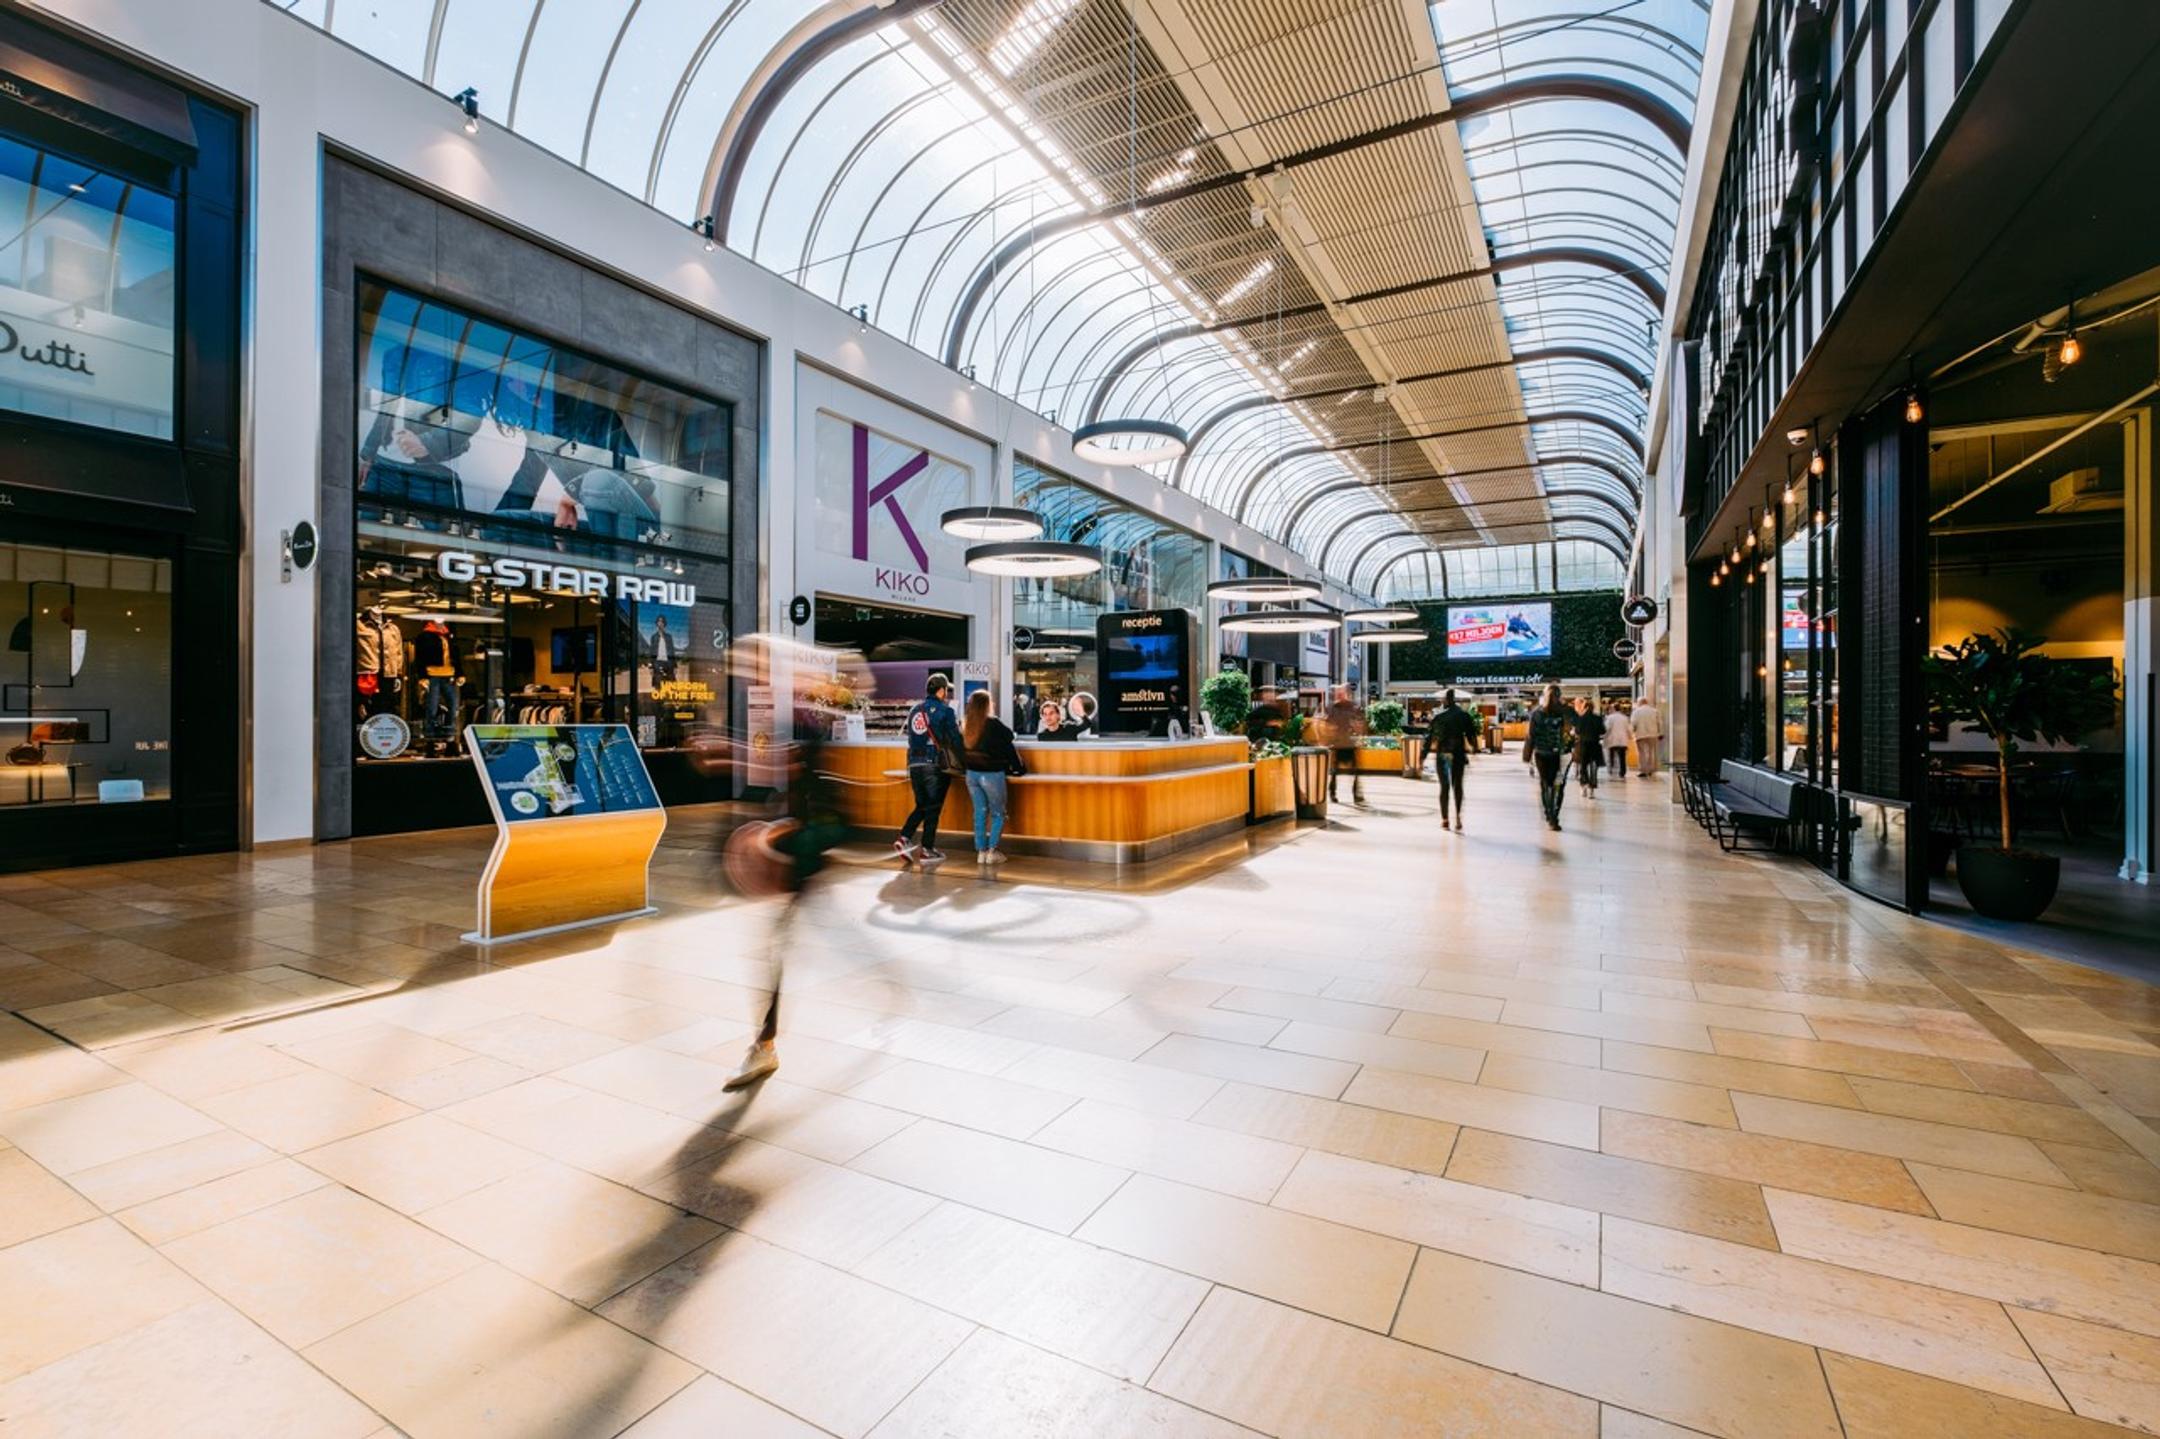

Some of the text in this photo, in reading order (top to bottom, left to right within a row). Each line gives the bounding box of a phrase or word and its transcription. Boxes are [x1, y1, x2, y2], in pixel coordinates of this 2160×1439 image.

[853, 424, 929, 575] K
[437, 551, 696, 608] G-STAR RAW
[875, 566, 930, 596] KIKO
[1121, 615, 1163, 629] receptie
[963, 663, 990, 676] KIKO
